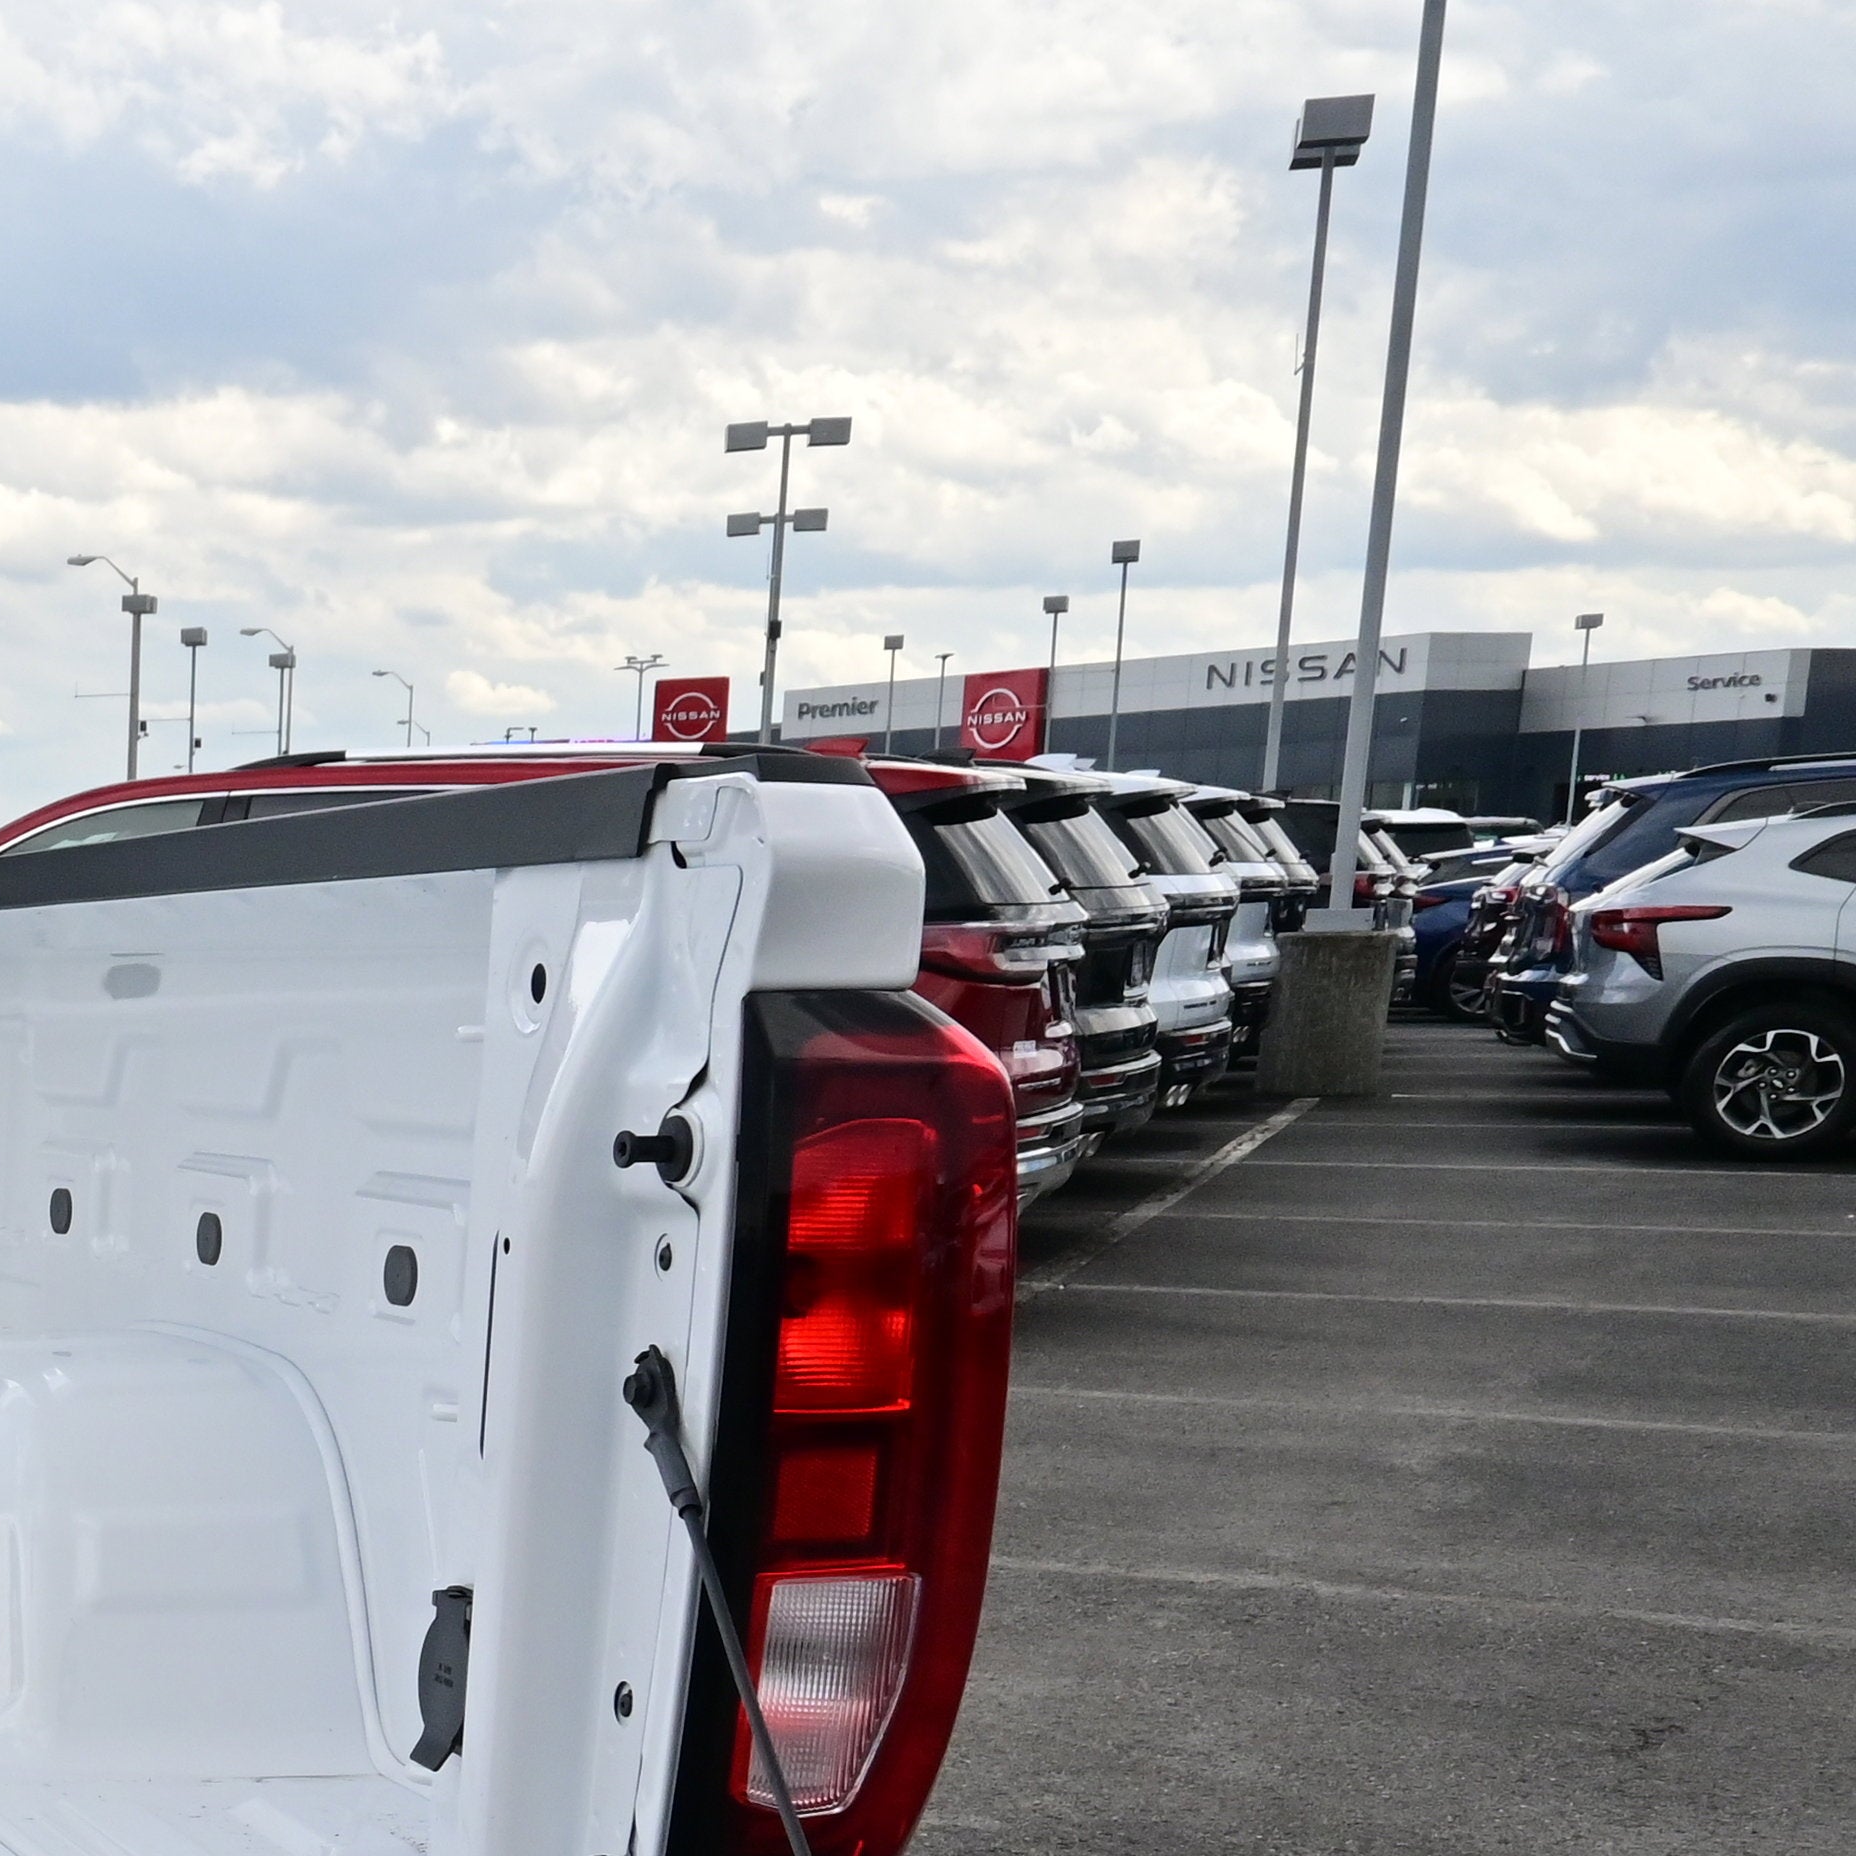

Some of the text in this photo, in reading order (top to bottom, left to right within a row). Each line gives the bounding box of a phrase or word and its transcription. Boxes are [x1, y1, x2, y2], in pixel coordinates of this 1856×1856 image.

[1206, 647, 1407, 690] NISSAN
[1687, 673, 1762, 691] Service
[661, 709, 720, 722] NISSAN
[797, 696, 880, 720] Premier
[967, 711, 1026, 726] NISSAN
